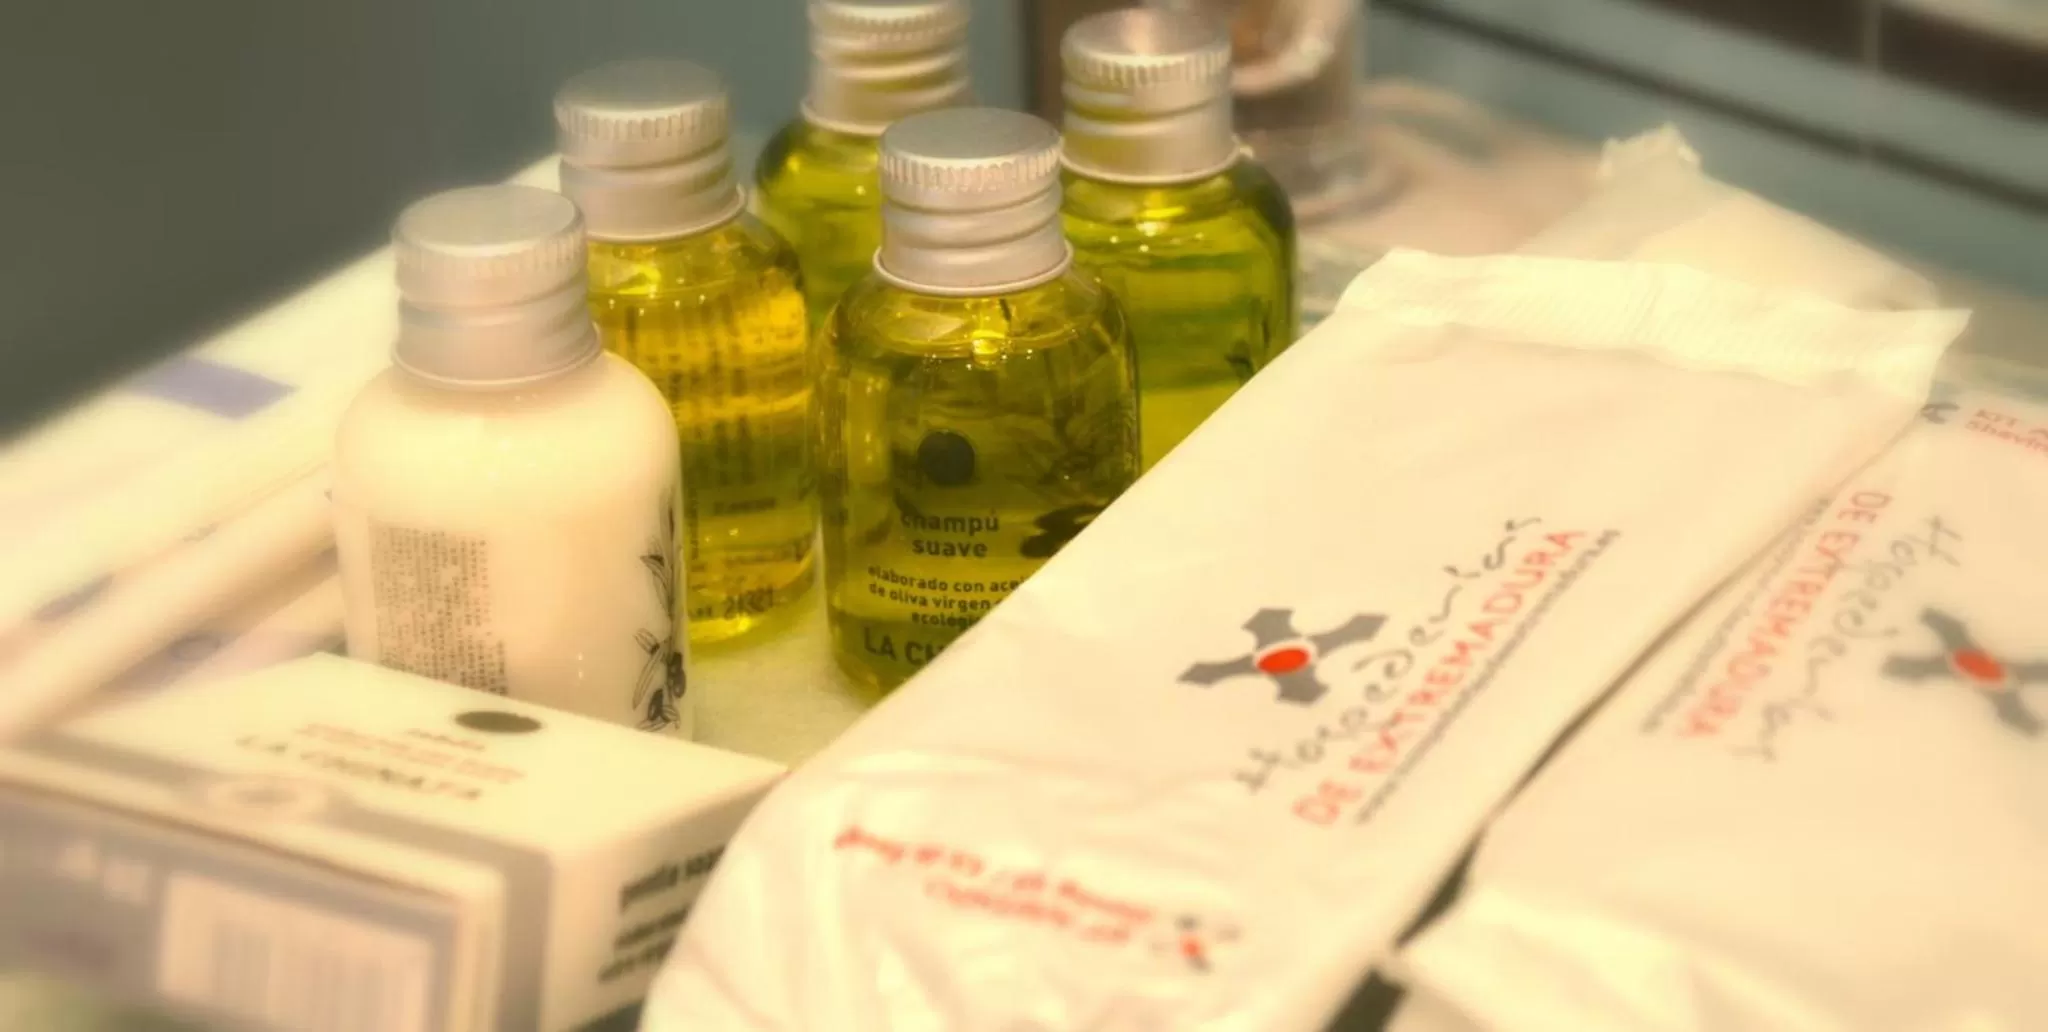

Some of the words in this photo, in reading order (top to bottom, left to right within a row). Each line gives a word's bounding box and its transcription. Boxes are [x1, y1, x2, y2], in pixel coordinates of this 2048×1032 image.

[911, 539, 988, 558] suave
[867, 566, 949, 592] elaborado
[953, 581, 985, 593] con
[868, 582, 886, 598] de
[889, 589, 928, 607] oliva
[932, 595, 992, 613] virgen
[863, 626, 898, 661] LA
[1348, 530, 1588, 774] EXTREMADURA
